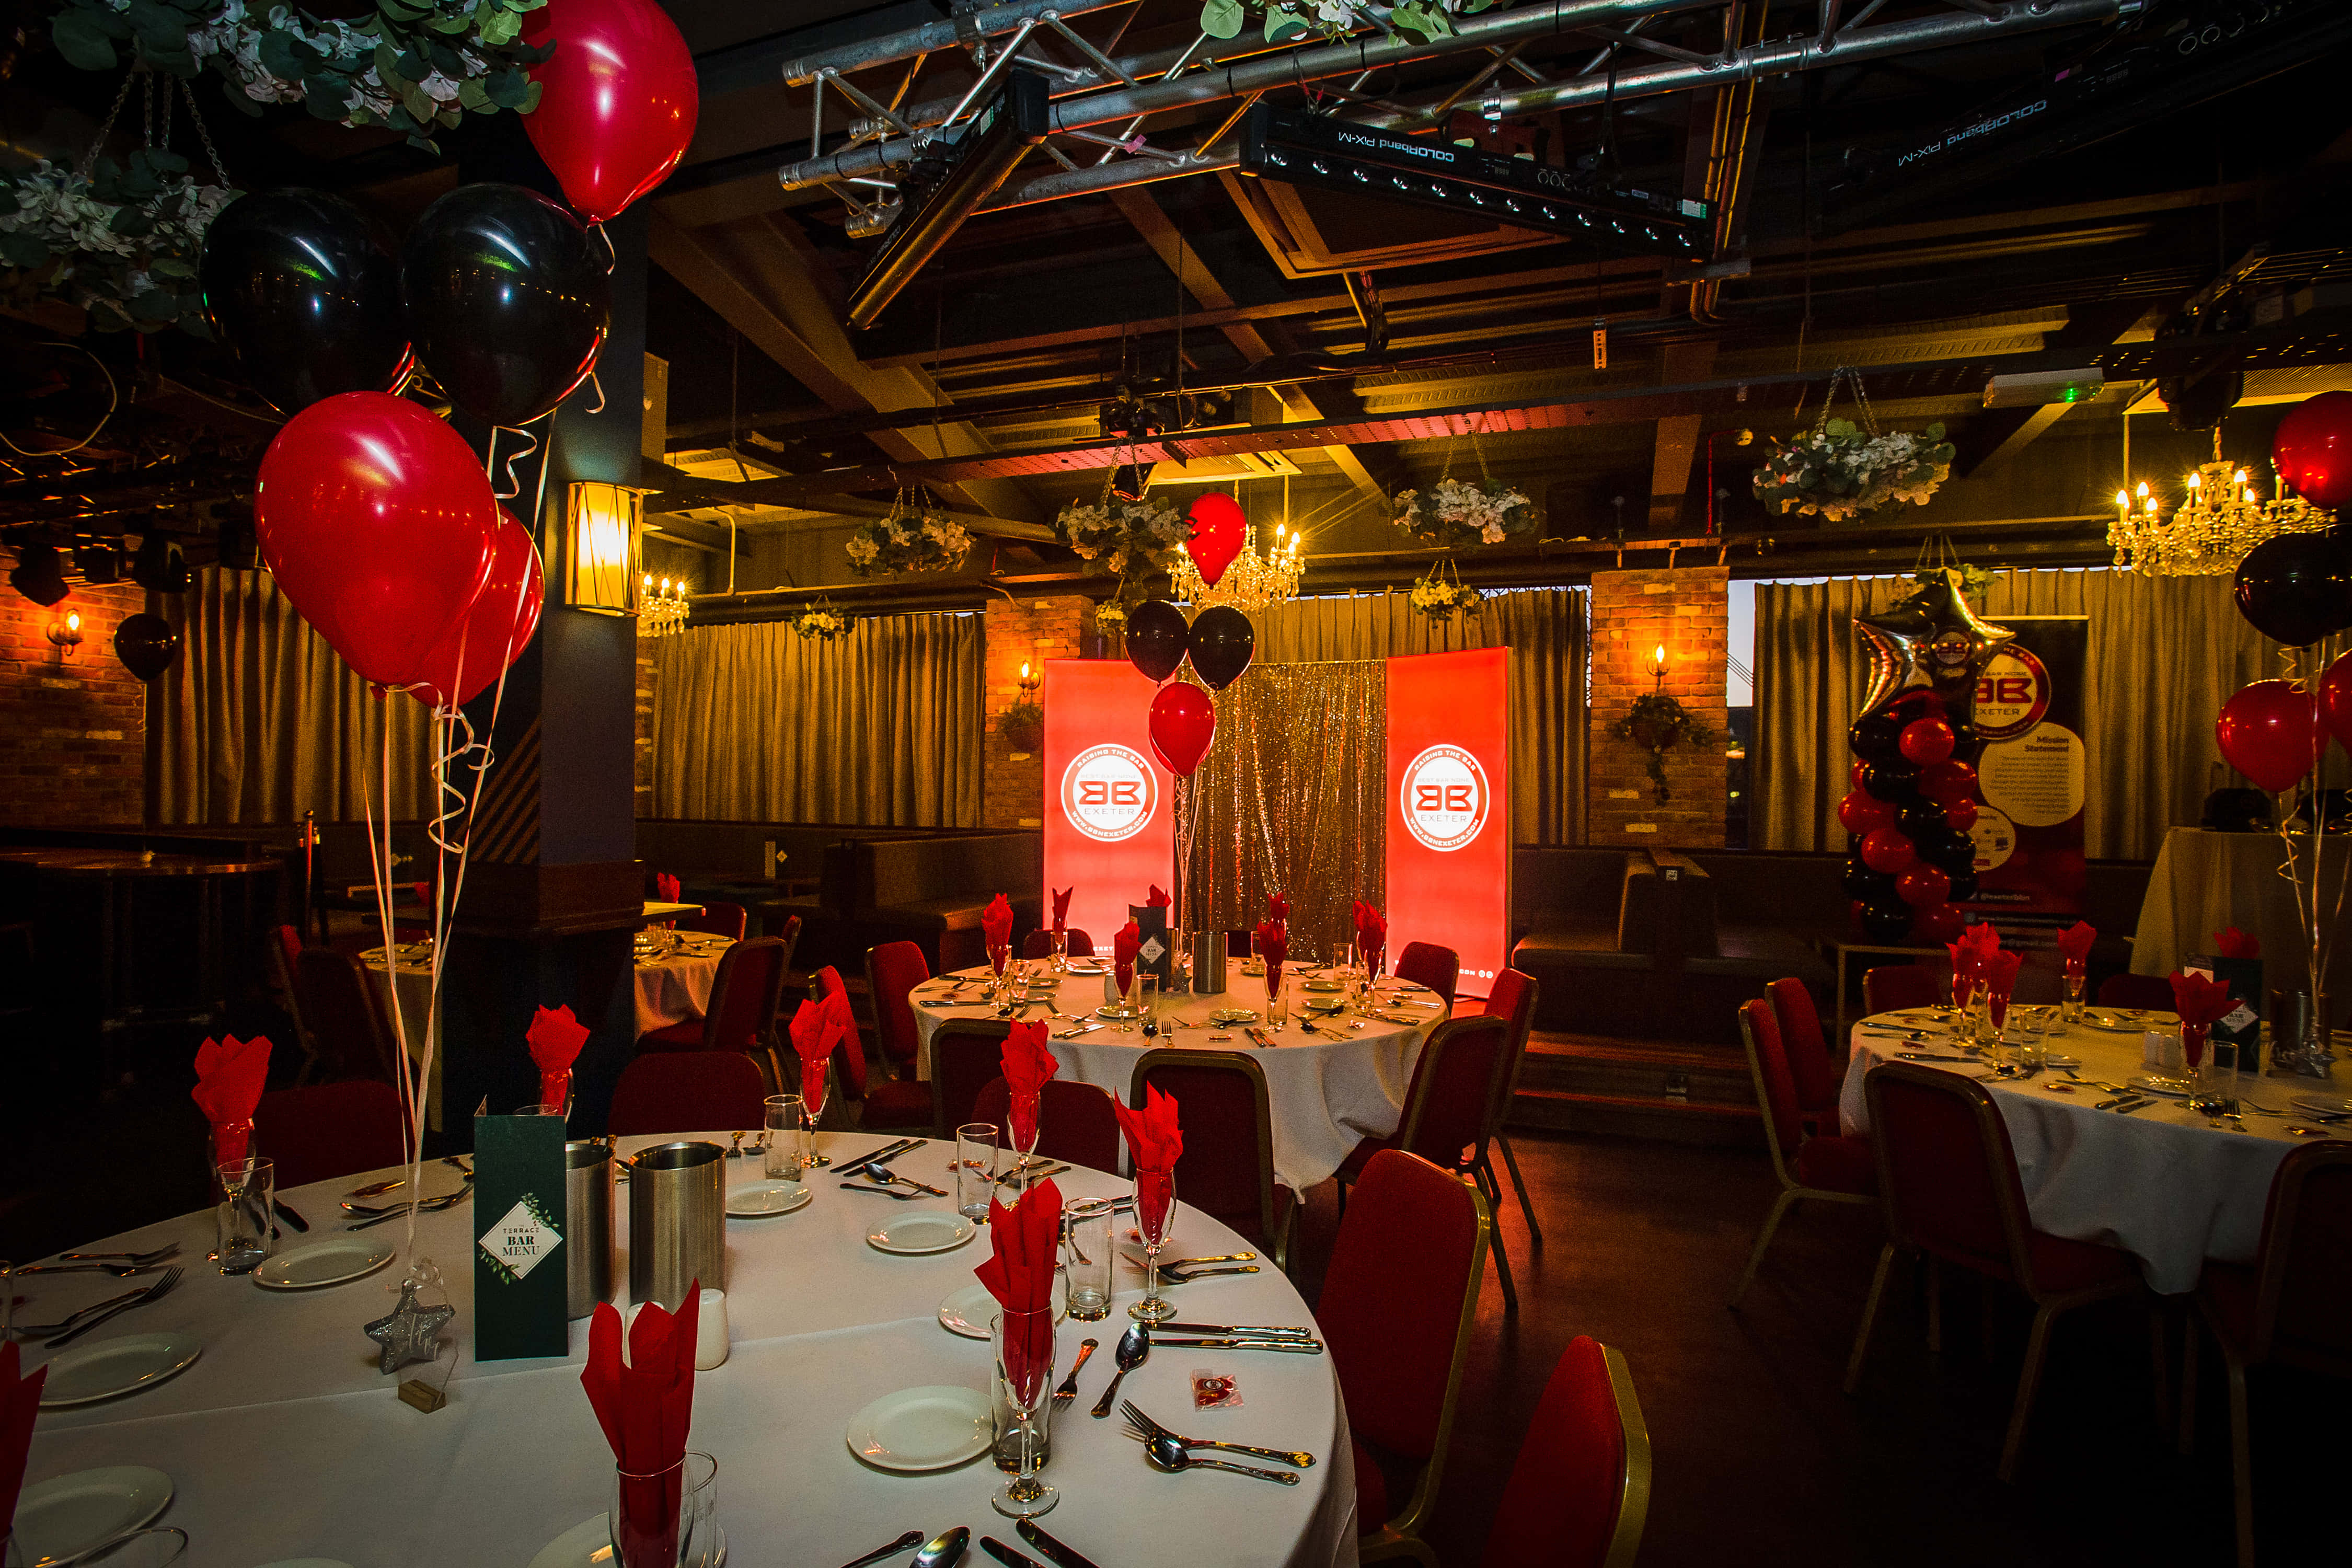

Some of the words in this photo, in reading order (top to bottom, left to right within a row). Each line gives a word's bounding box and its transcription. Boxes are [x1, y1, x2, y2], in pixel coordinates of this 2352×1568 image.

[1946, 99, 2047, 147] COLORband
[1379, 139, 1455, 163] COLORband
[1077, 749, 1109, 768] RAISING
[1111, 749, 1127, 757] THE
[1129, 755, 1145, 769] BAR
[1414, 750, 1443, 771] RAISING
[1445, 750, 1461, 758] THE
[1462, 757, 1477, 771] BAR
[1421, 814, 1467, 823] EXETER
[502, 1246, 540, 1256] MENU
[508, 1236, 534, 1246] BAR
